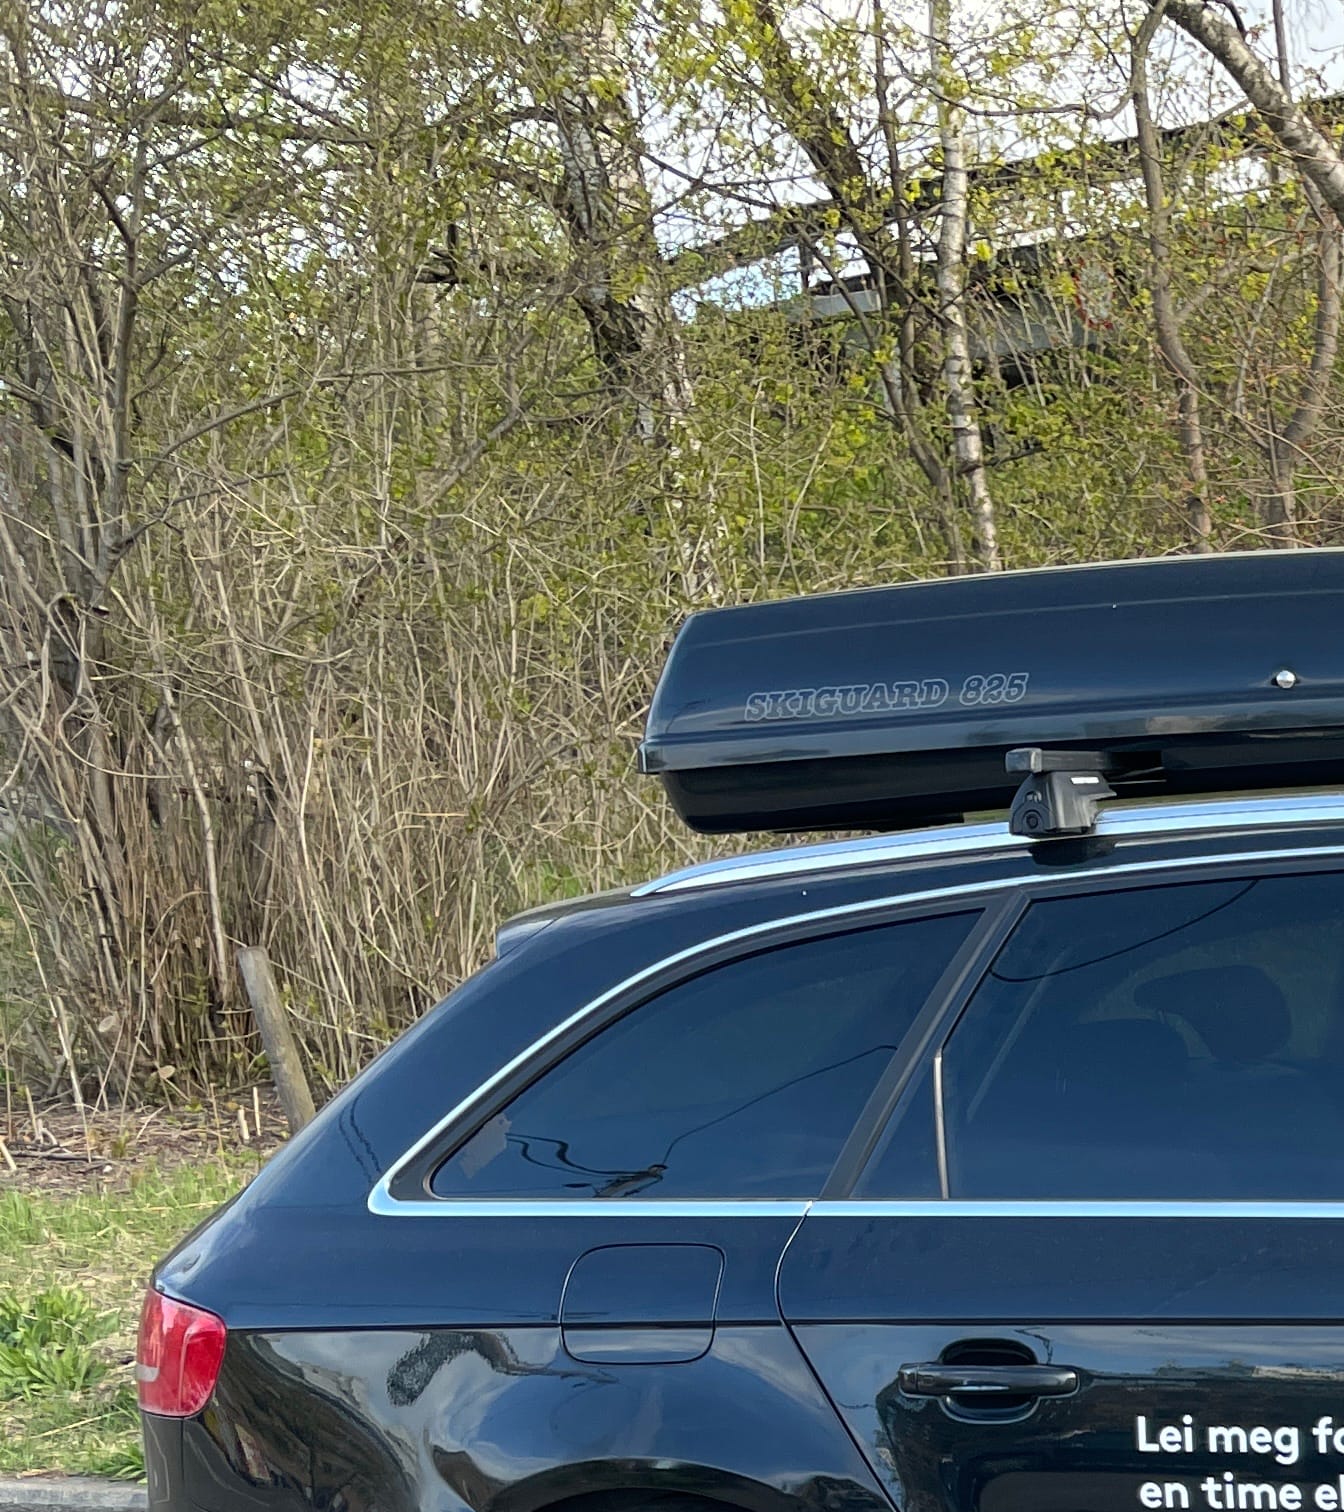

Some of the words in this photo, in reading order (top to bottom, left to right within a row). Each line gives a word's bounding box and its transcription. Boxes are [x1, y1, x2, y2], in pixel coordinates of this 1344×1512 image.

[744, 678, 949, 722] SKIGUARD
[959, 672, 1030, 706] 825
[1137, 1415, 1193, 1452] Lei
[1208, 1427, 1299, 1464] meg
[1140, 1482, 1189, 1508] en
[1201, 1472, 1302, 1510] time
